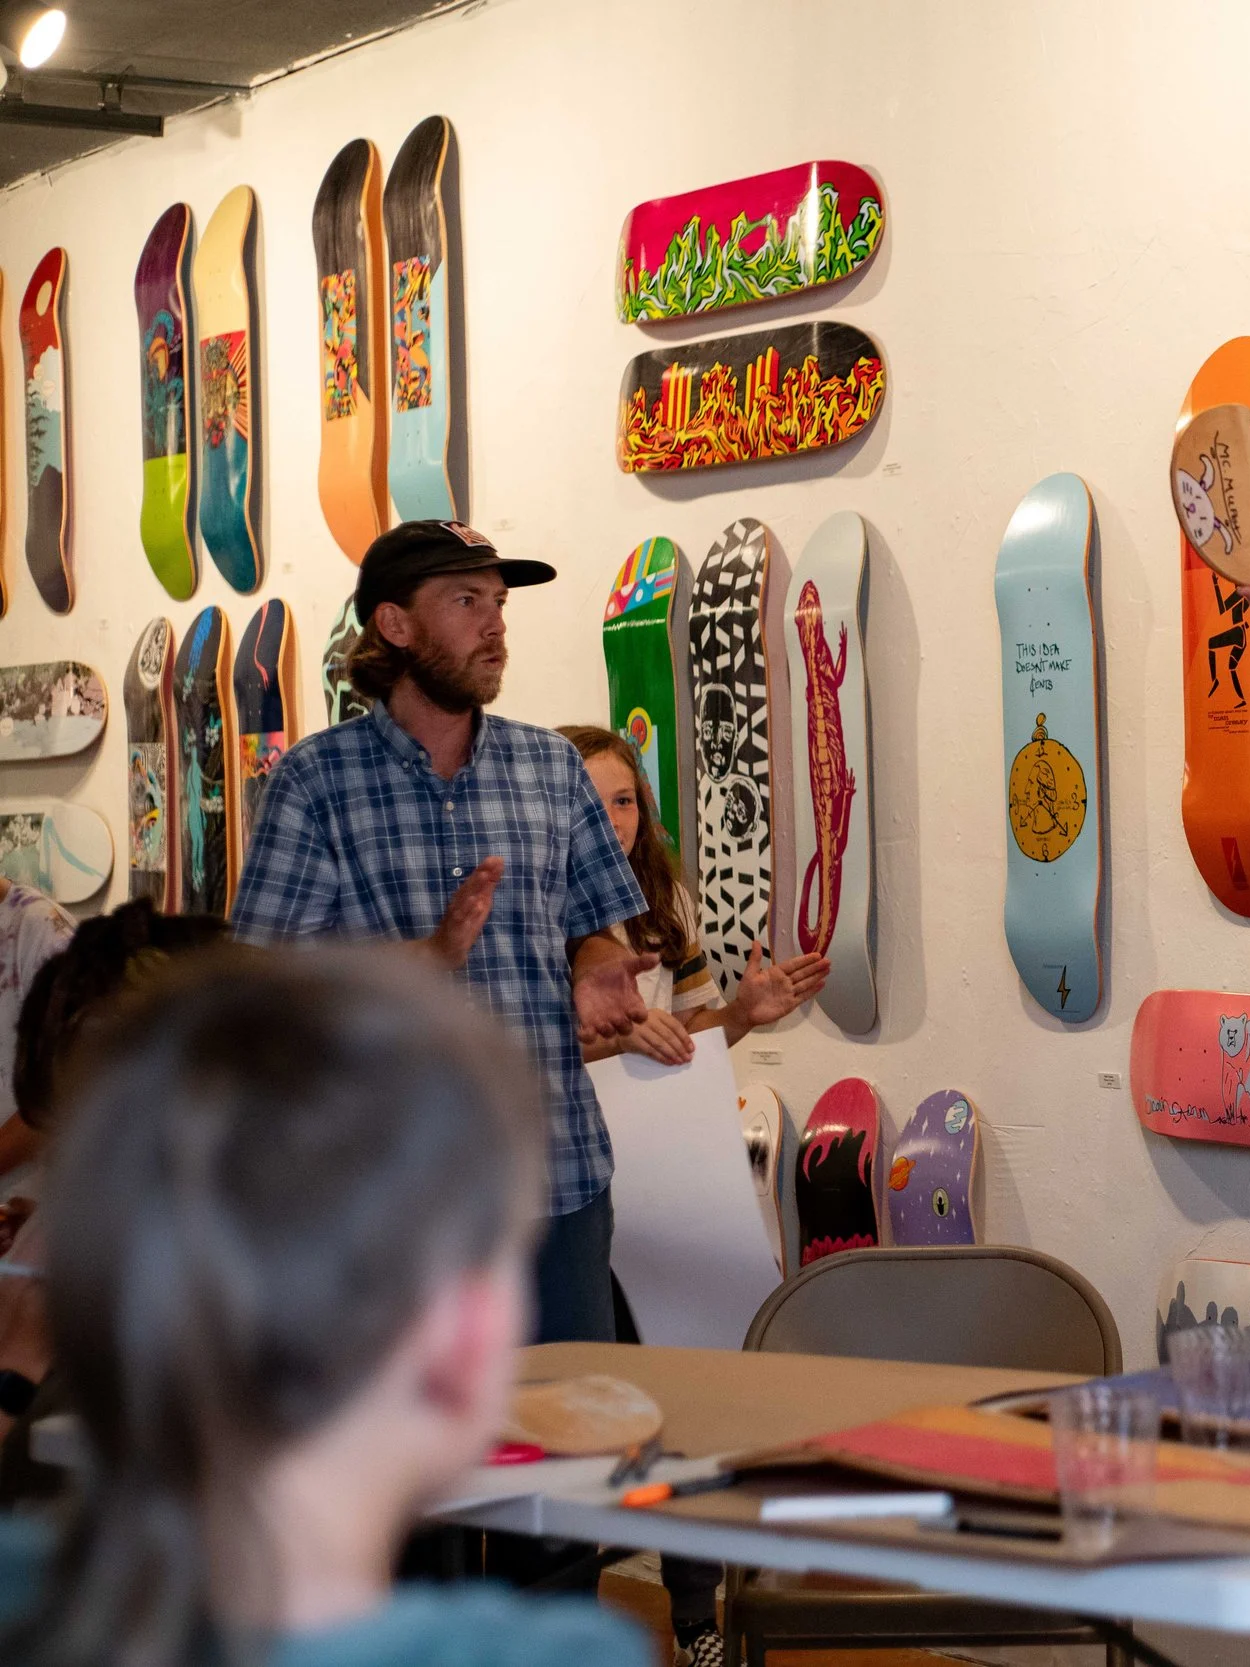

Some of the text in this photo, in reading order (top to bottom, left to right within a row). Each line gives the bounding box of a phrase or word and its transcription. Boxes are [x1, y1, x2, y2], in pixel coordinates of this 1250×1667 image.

[1016, 643, 1060, 659] THIS IDEA
[1048, 658, 1073, 672] MAKE
